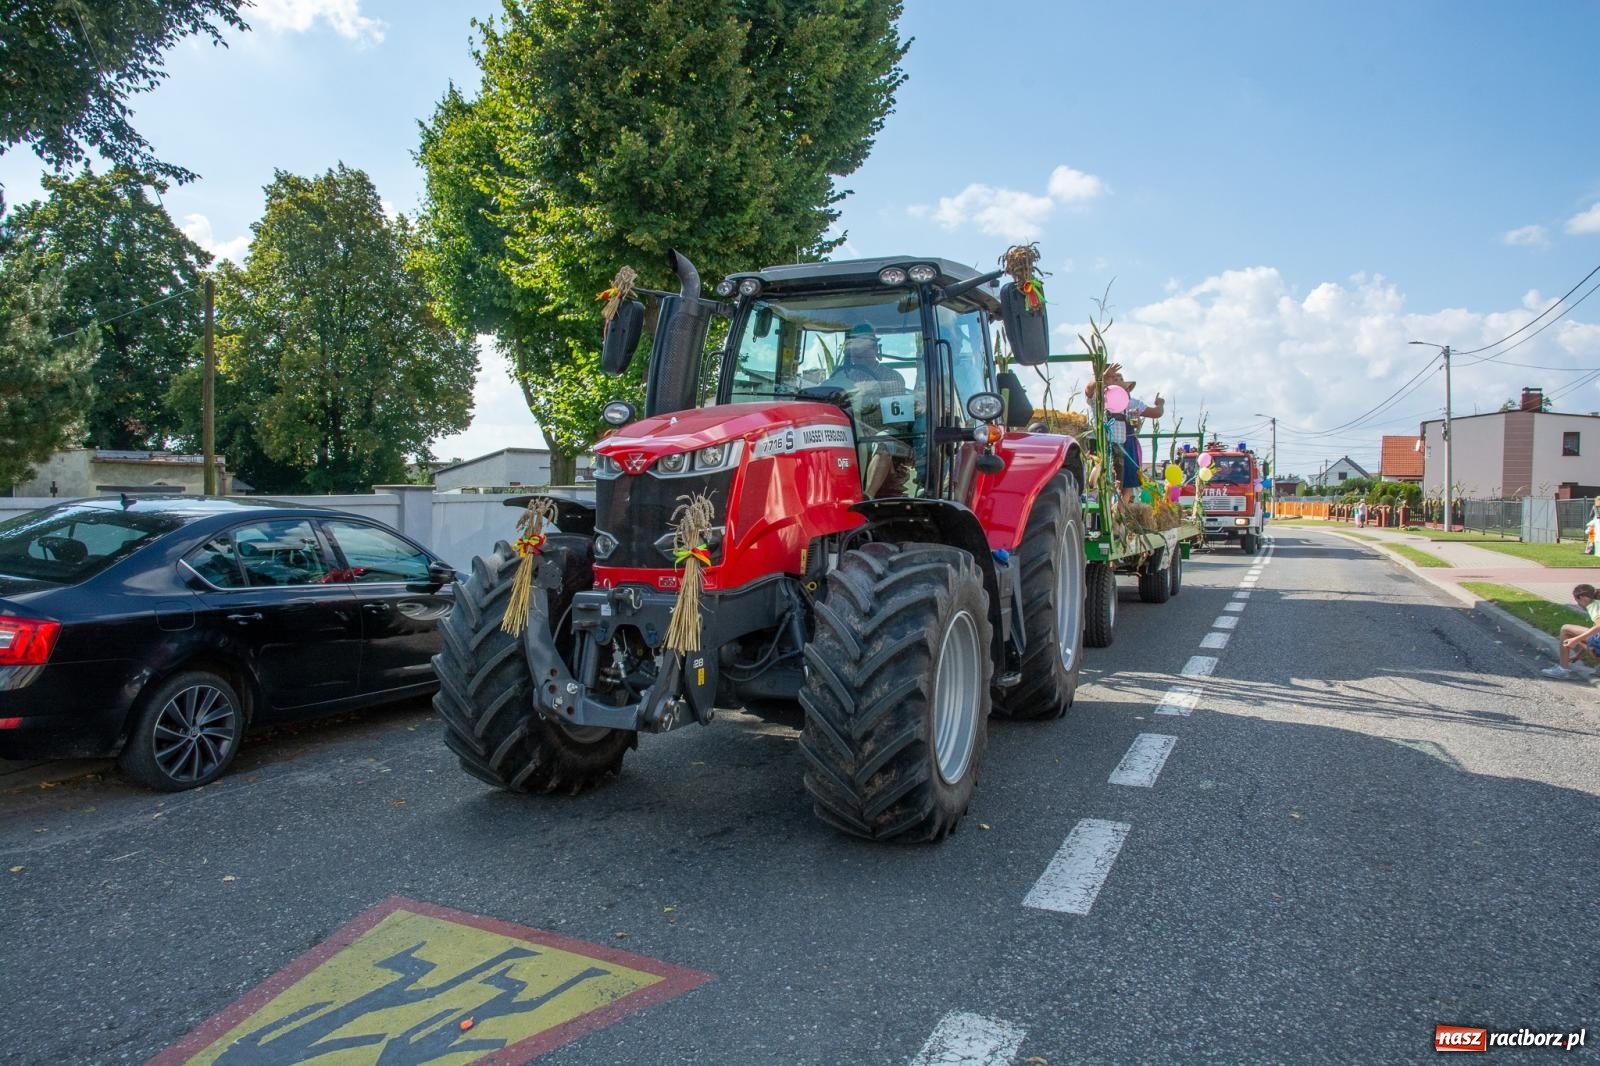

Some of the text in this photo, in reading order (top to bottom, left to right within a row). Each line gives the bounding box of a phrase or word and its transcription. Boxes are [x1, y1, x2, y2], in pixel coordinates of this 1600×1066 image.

[890, 401, 905, 416] 6.
[763, 429, 848, 452] 7716 S MASSEY FERGUSON
